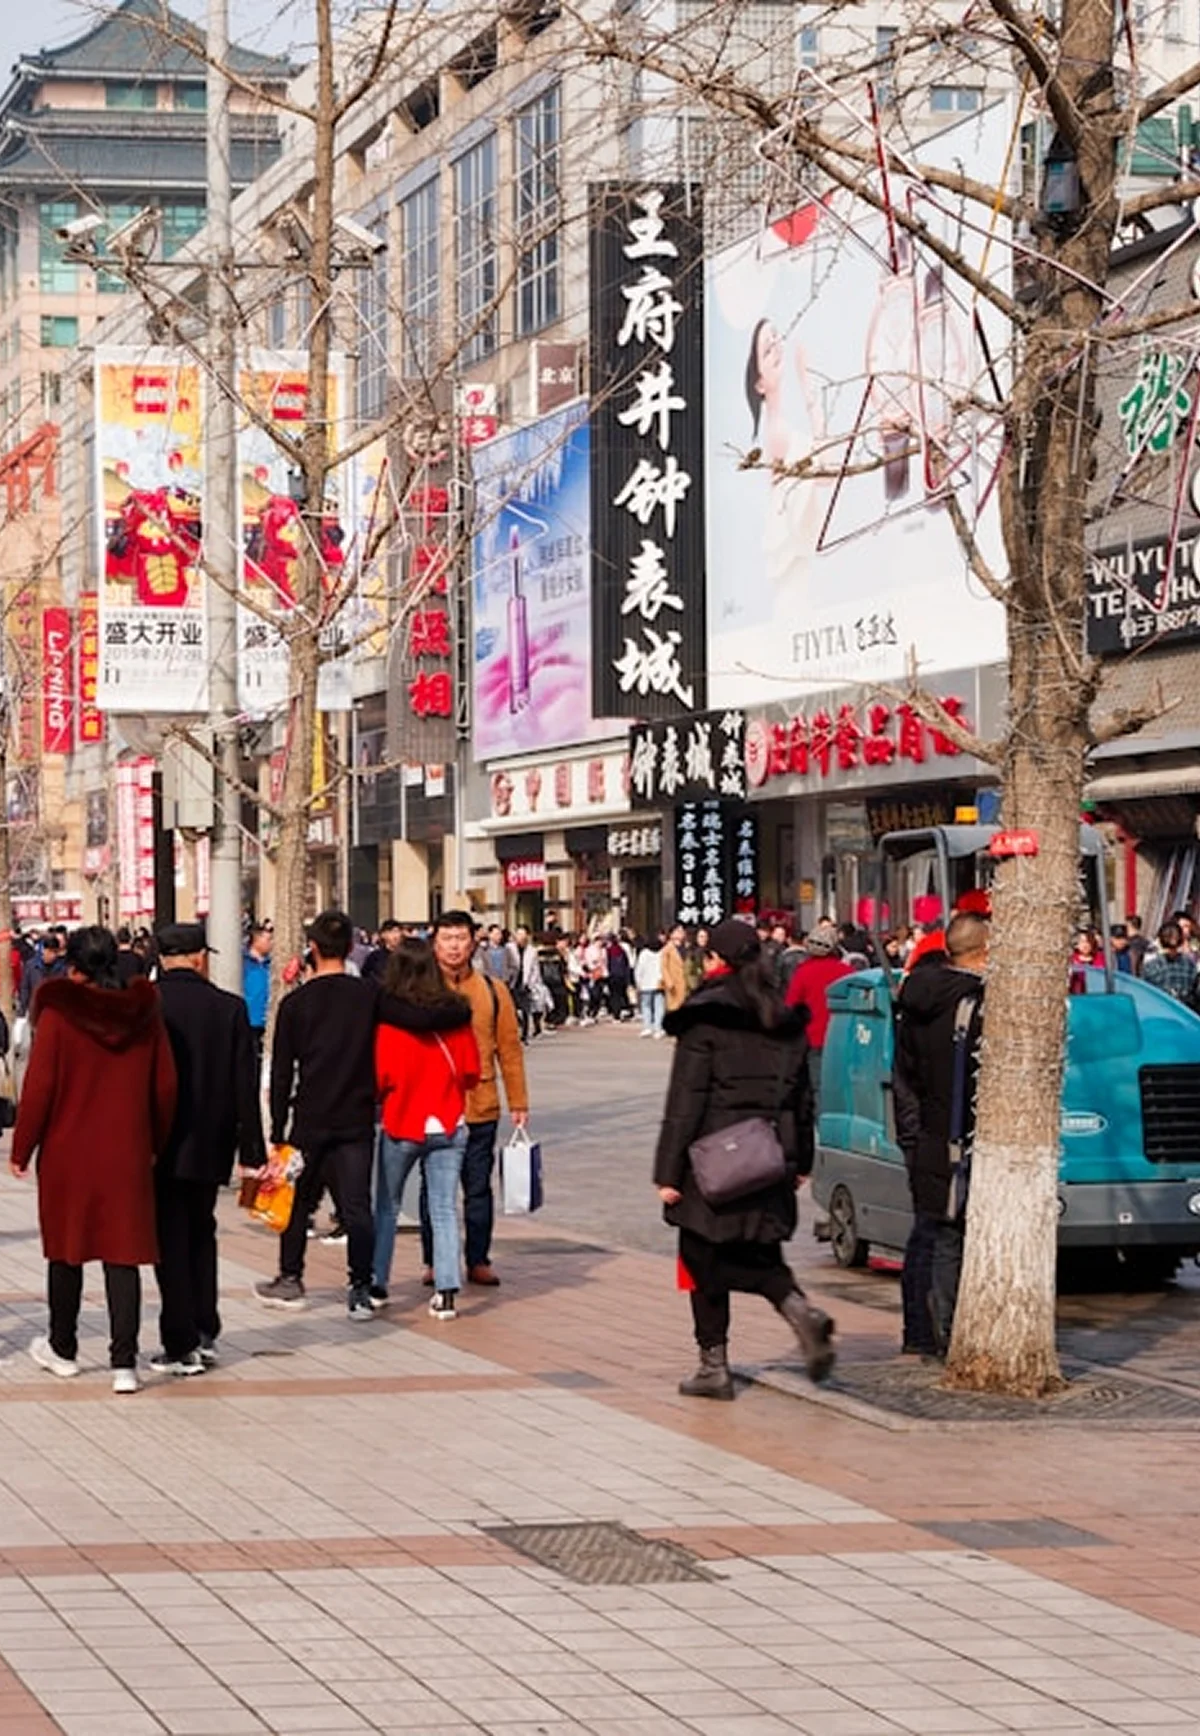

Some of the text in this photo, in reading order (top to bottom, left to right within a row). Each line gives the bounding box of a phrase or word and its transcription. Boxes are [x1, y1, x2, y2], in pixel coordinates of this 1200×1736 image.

[540, 366, 574, 385] 北京
[613, 191, 694, 708] 王府井钟表城
[105, 620, 203, 646] 盛大开业
[792, 625, 848, 663] FIYTA
[631, 721, 715, 800] 钟表城
[719, 711, 745, 798] 钟表城
